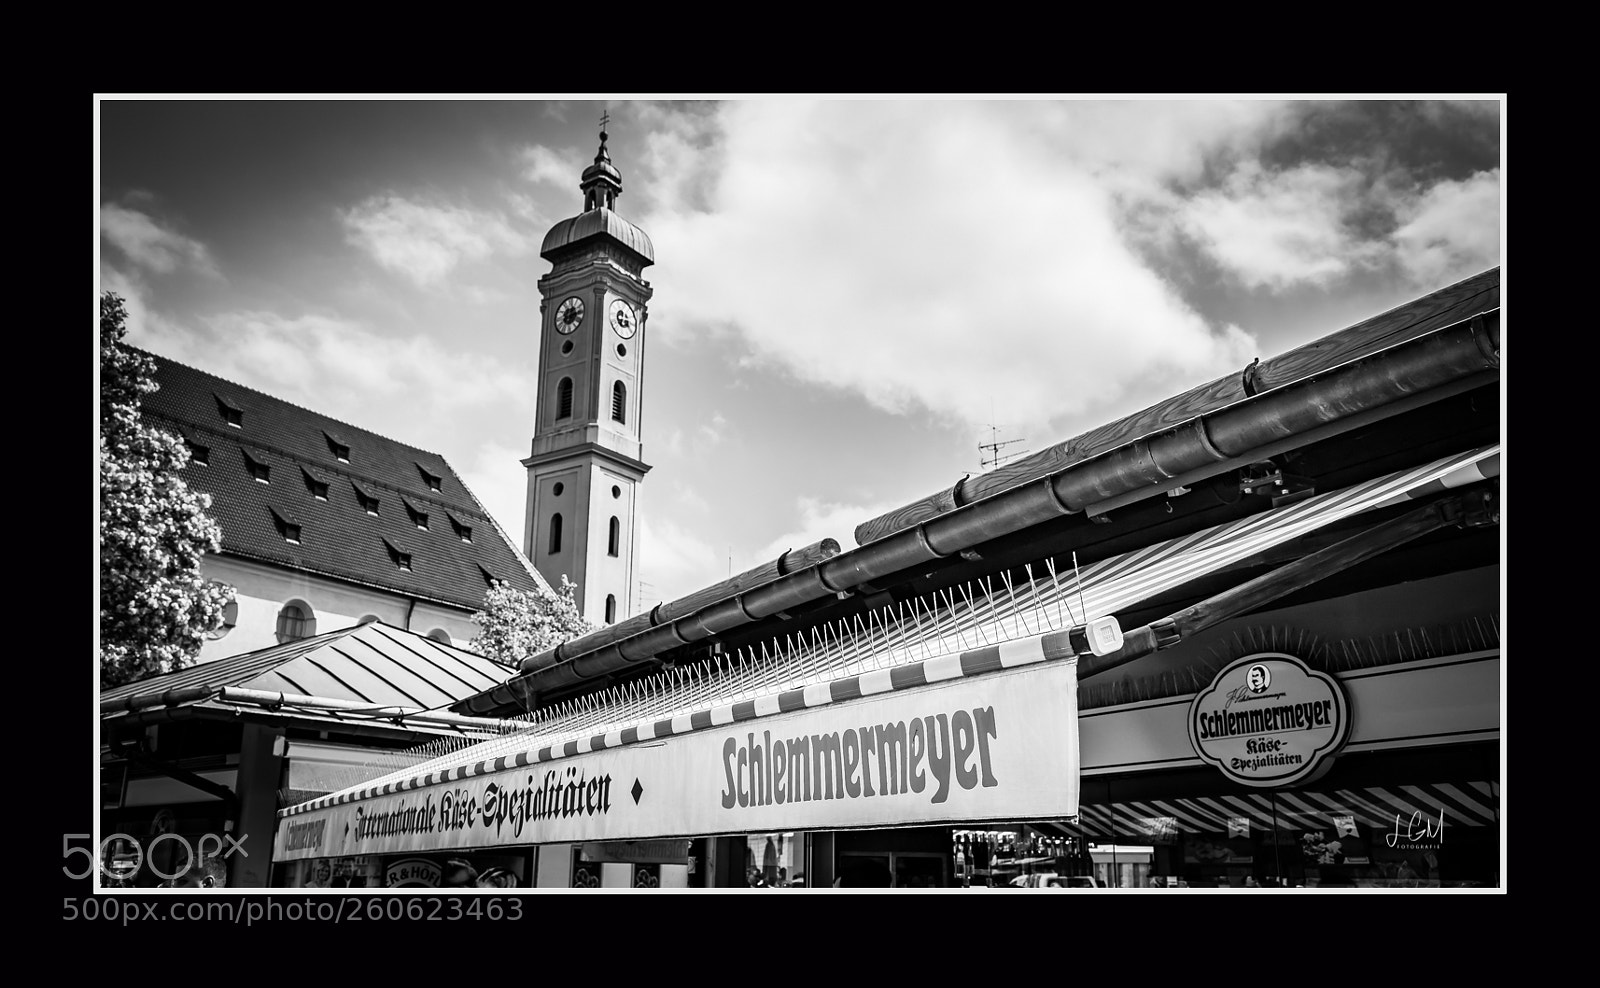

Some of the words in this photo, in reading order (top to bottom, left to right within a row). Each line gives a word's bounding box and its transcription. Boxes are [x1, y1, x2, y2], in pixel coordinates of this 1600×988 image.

[1200, 699, 1331, 740] Schlemmermeyer
[721, 705, 998, 810] Schlemmermeyer
[1246, 737, 1288, 755] Käse-
[1230, 753, 1303, 772] Spezialitäten
[355, 793, 436, 842] Internationale
[438, 766, 612, 839] Käse-Spezialitäten
[387, 871, 400, 887] R
[400, 868, 409, 879] &
